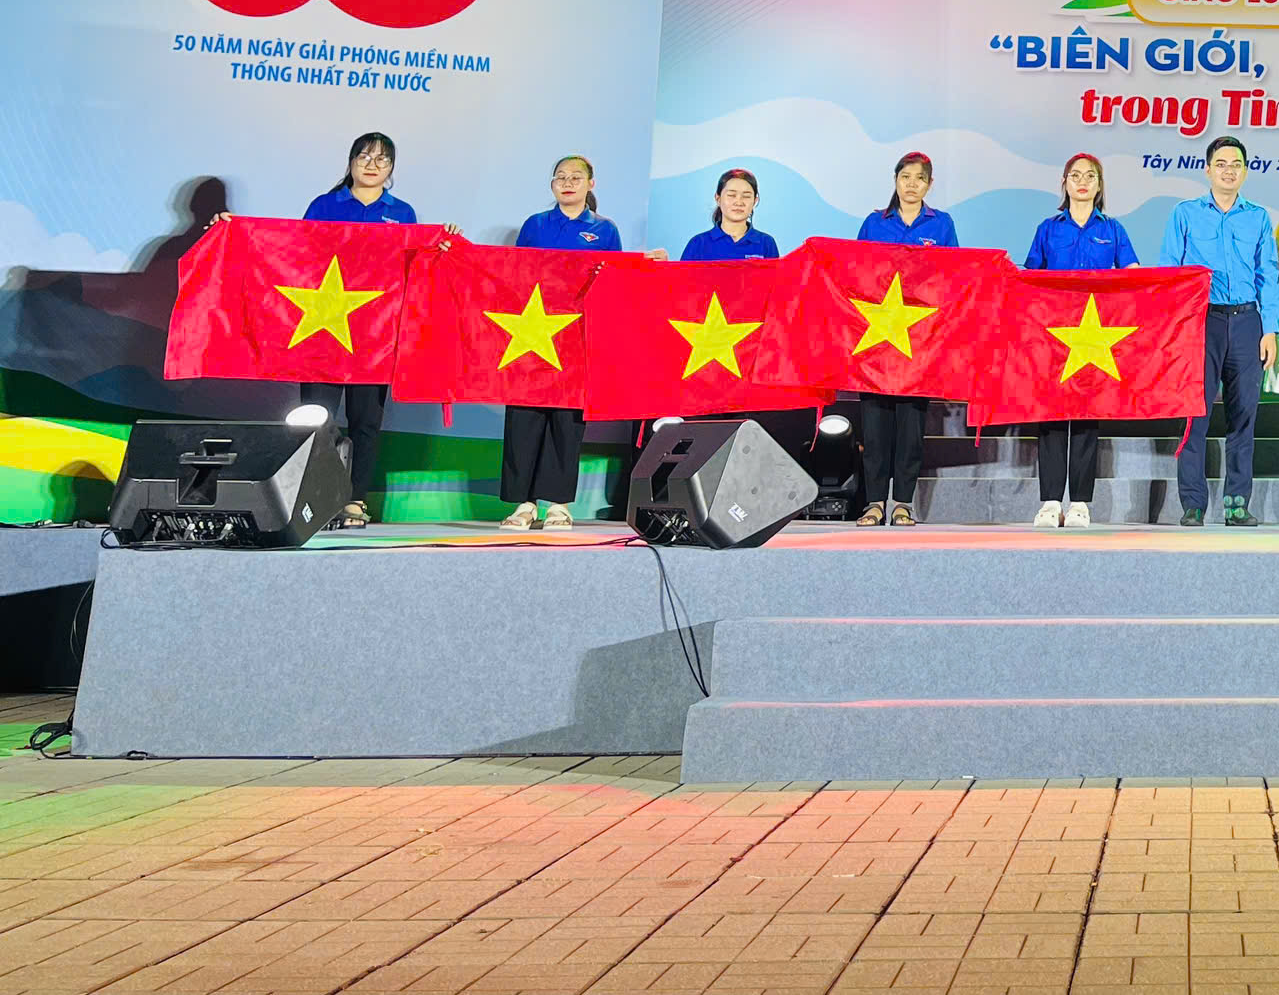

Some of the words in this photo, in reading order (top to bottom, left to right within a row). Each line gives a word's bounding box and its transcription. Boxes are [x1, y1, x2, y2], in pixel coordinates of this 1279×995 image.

[173, 34, 196, 52] 50
[200, 33, 242, 54] NĂM
[247, 37, 296, 58] NGÀY
[299, 39, 335, 61] GIẢI
[339, 45, 400, 66] PHÓNG
[404, 48, 448, 69] MIỀN
[452, 55, 491, 73] NAM
[1144, 29, 1265, 79] GIỚI,
[231, 59, 292, 82] THỐNG
[297, 64, 344, 86] NHẤT
[347, 67, 380, 89] ĐẤT
[384, 72, 432, 92] NƯỚC
[1080, 88, 1209, 136] trong
[1142, 154, 1173, 172] Tây
[1177, 155, 1206, 169] Nin
